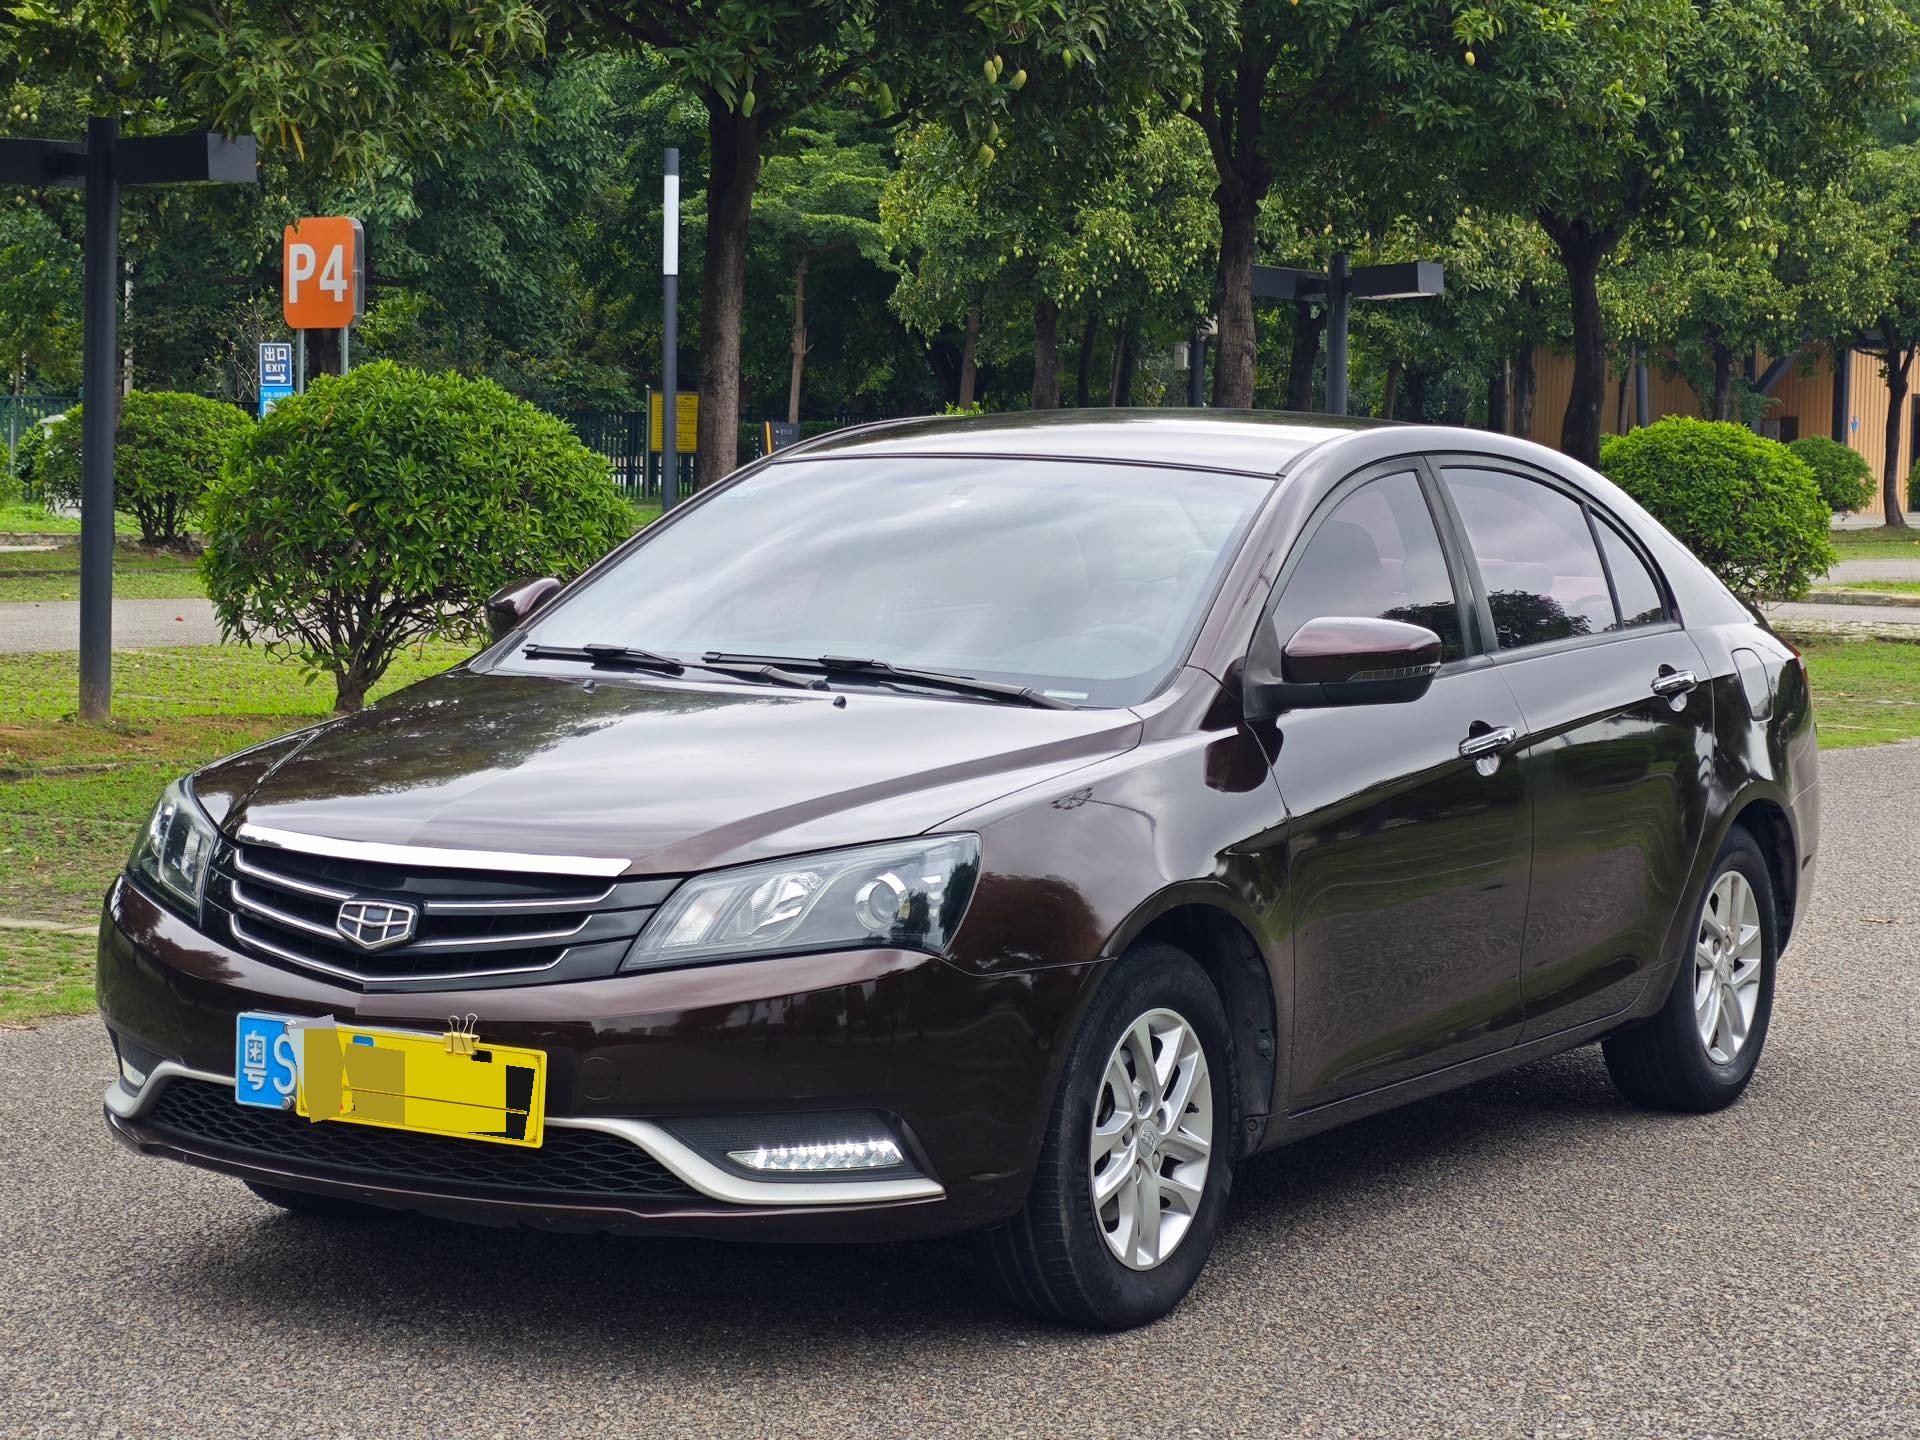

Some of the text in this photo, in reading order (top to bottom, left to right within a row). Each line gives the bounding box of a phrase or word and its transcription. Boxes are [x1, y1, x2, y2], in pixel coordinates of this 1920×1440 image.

[288, 244, 348, 304] P4
[264, 347, 287, 361] 出口
[265, 363, 287, 373] EXIT
